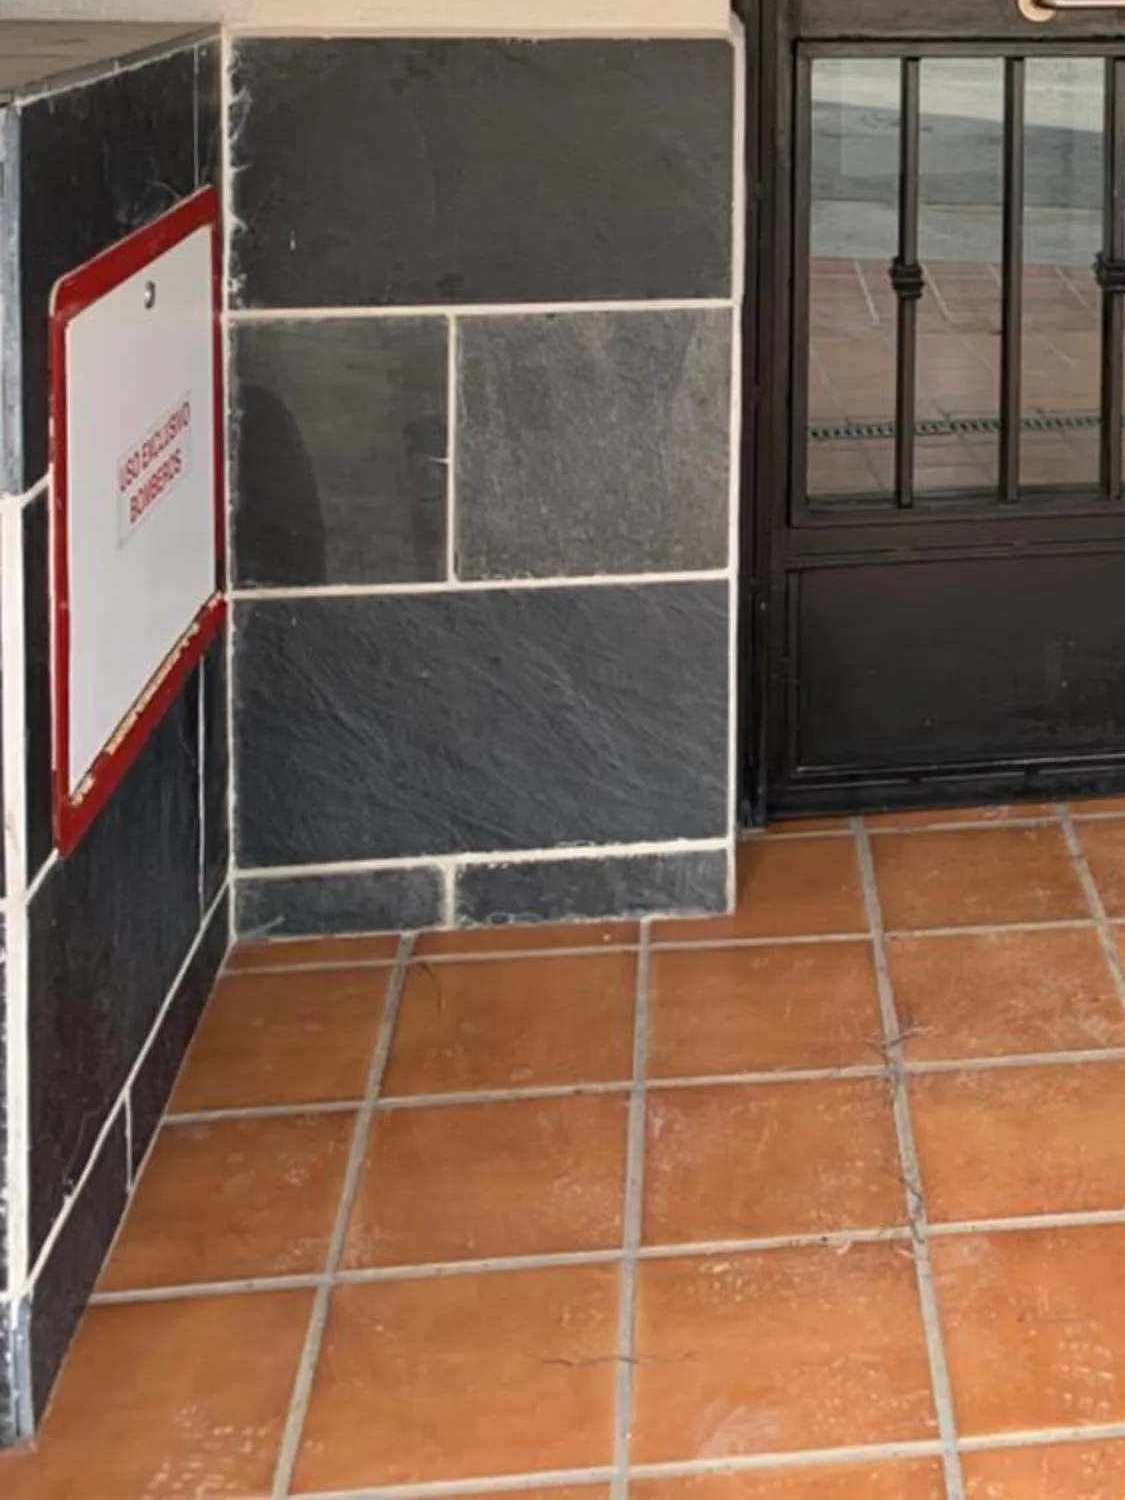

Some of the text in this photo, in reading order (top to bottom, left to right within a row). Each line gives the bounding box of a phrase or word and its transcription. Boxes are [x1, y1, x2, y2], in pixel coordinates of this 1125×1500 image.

[118, 401, 191, 492] USO EXCLUSIVO
[130, 448, 182, 523] BOMBEROS
